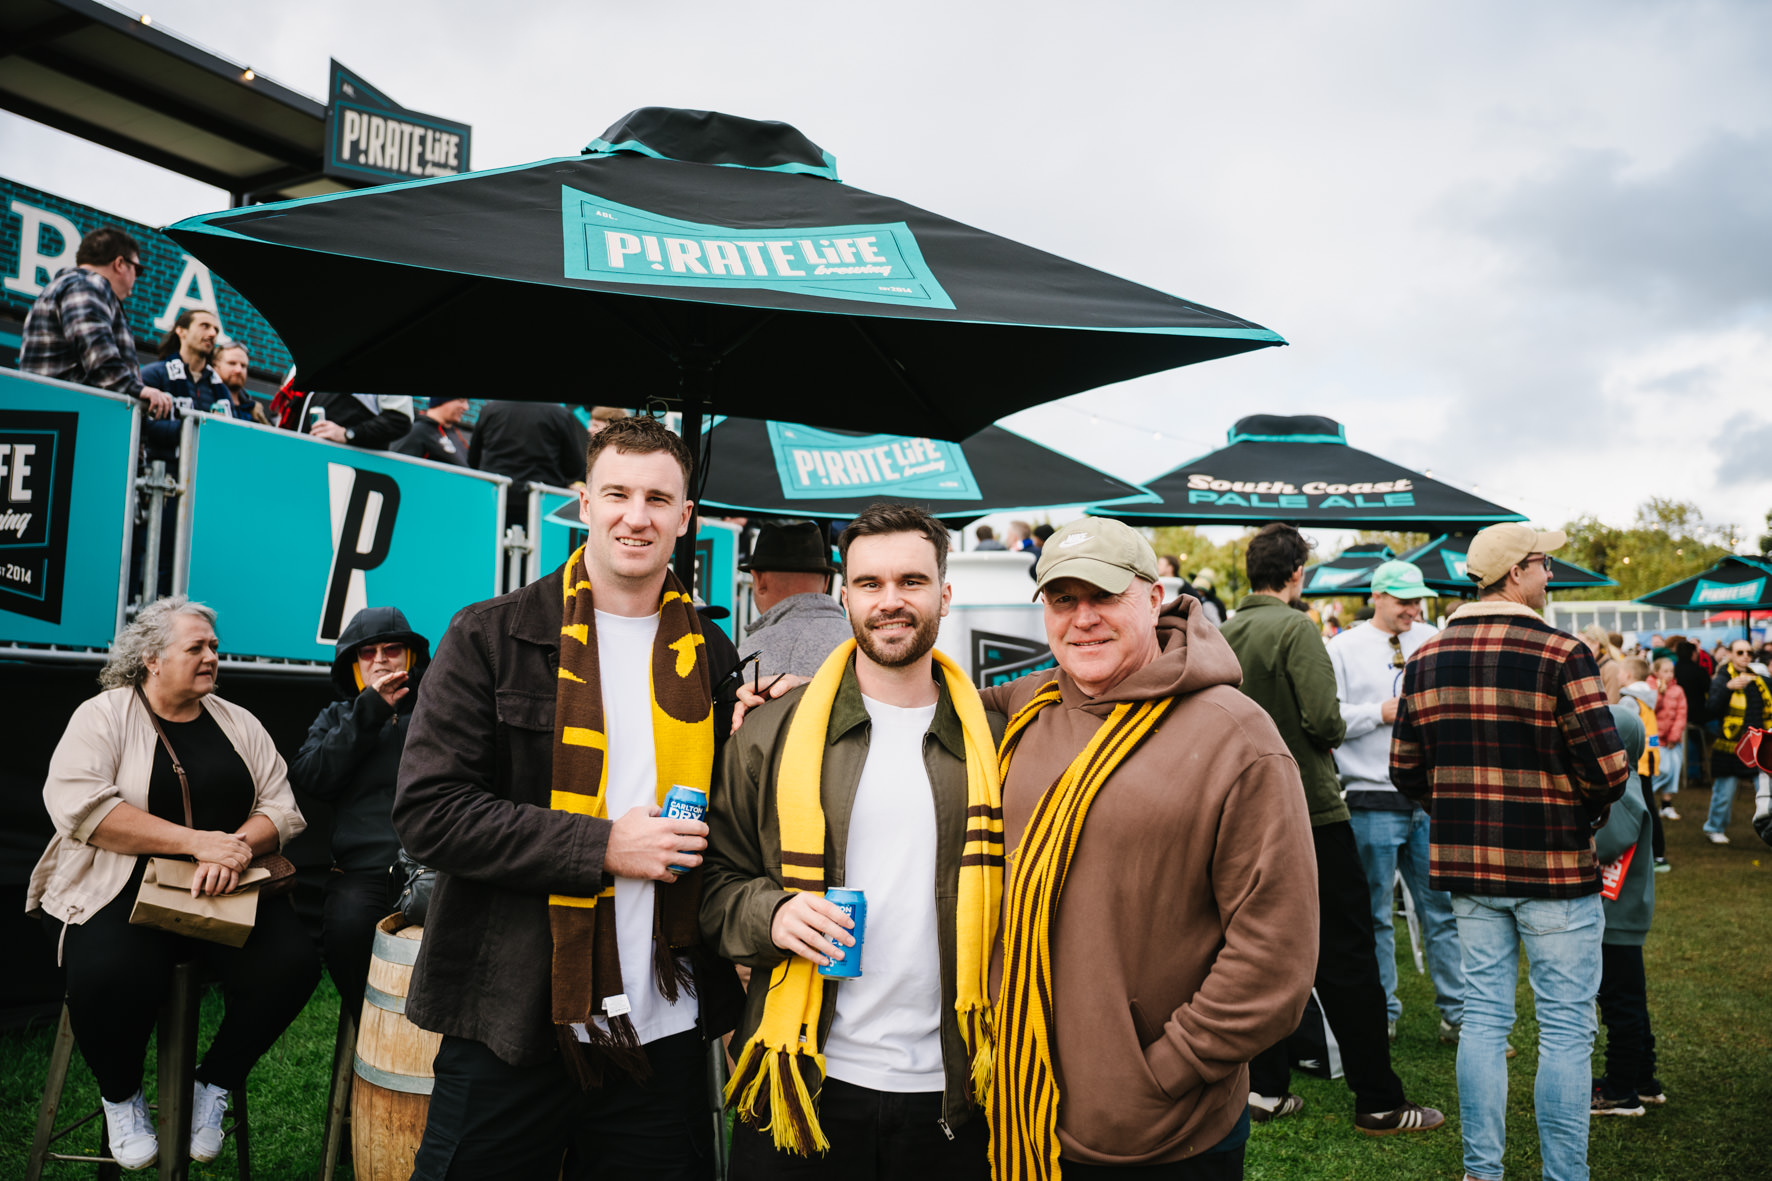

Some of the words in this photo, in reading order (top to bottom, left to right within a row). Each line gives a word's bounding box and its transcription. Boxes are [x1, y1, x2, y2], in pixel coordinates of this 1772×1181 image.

[1187, 474, 1299, 495] South
[1302, 479, 1414, 495] Coast
[1188, 489, 1308, 508] PALE
[1318, 492, 1416, 508] ALE
[316, 462, 401, 646] P
[6, 563, 32, 585] 2014
[668, 807, 702, 820] DRY
[670, 801, 703, 813] CARLTON
